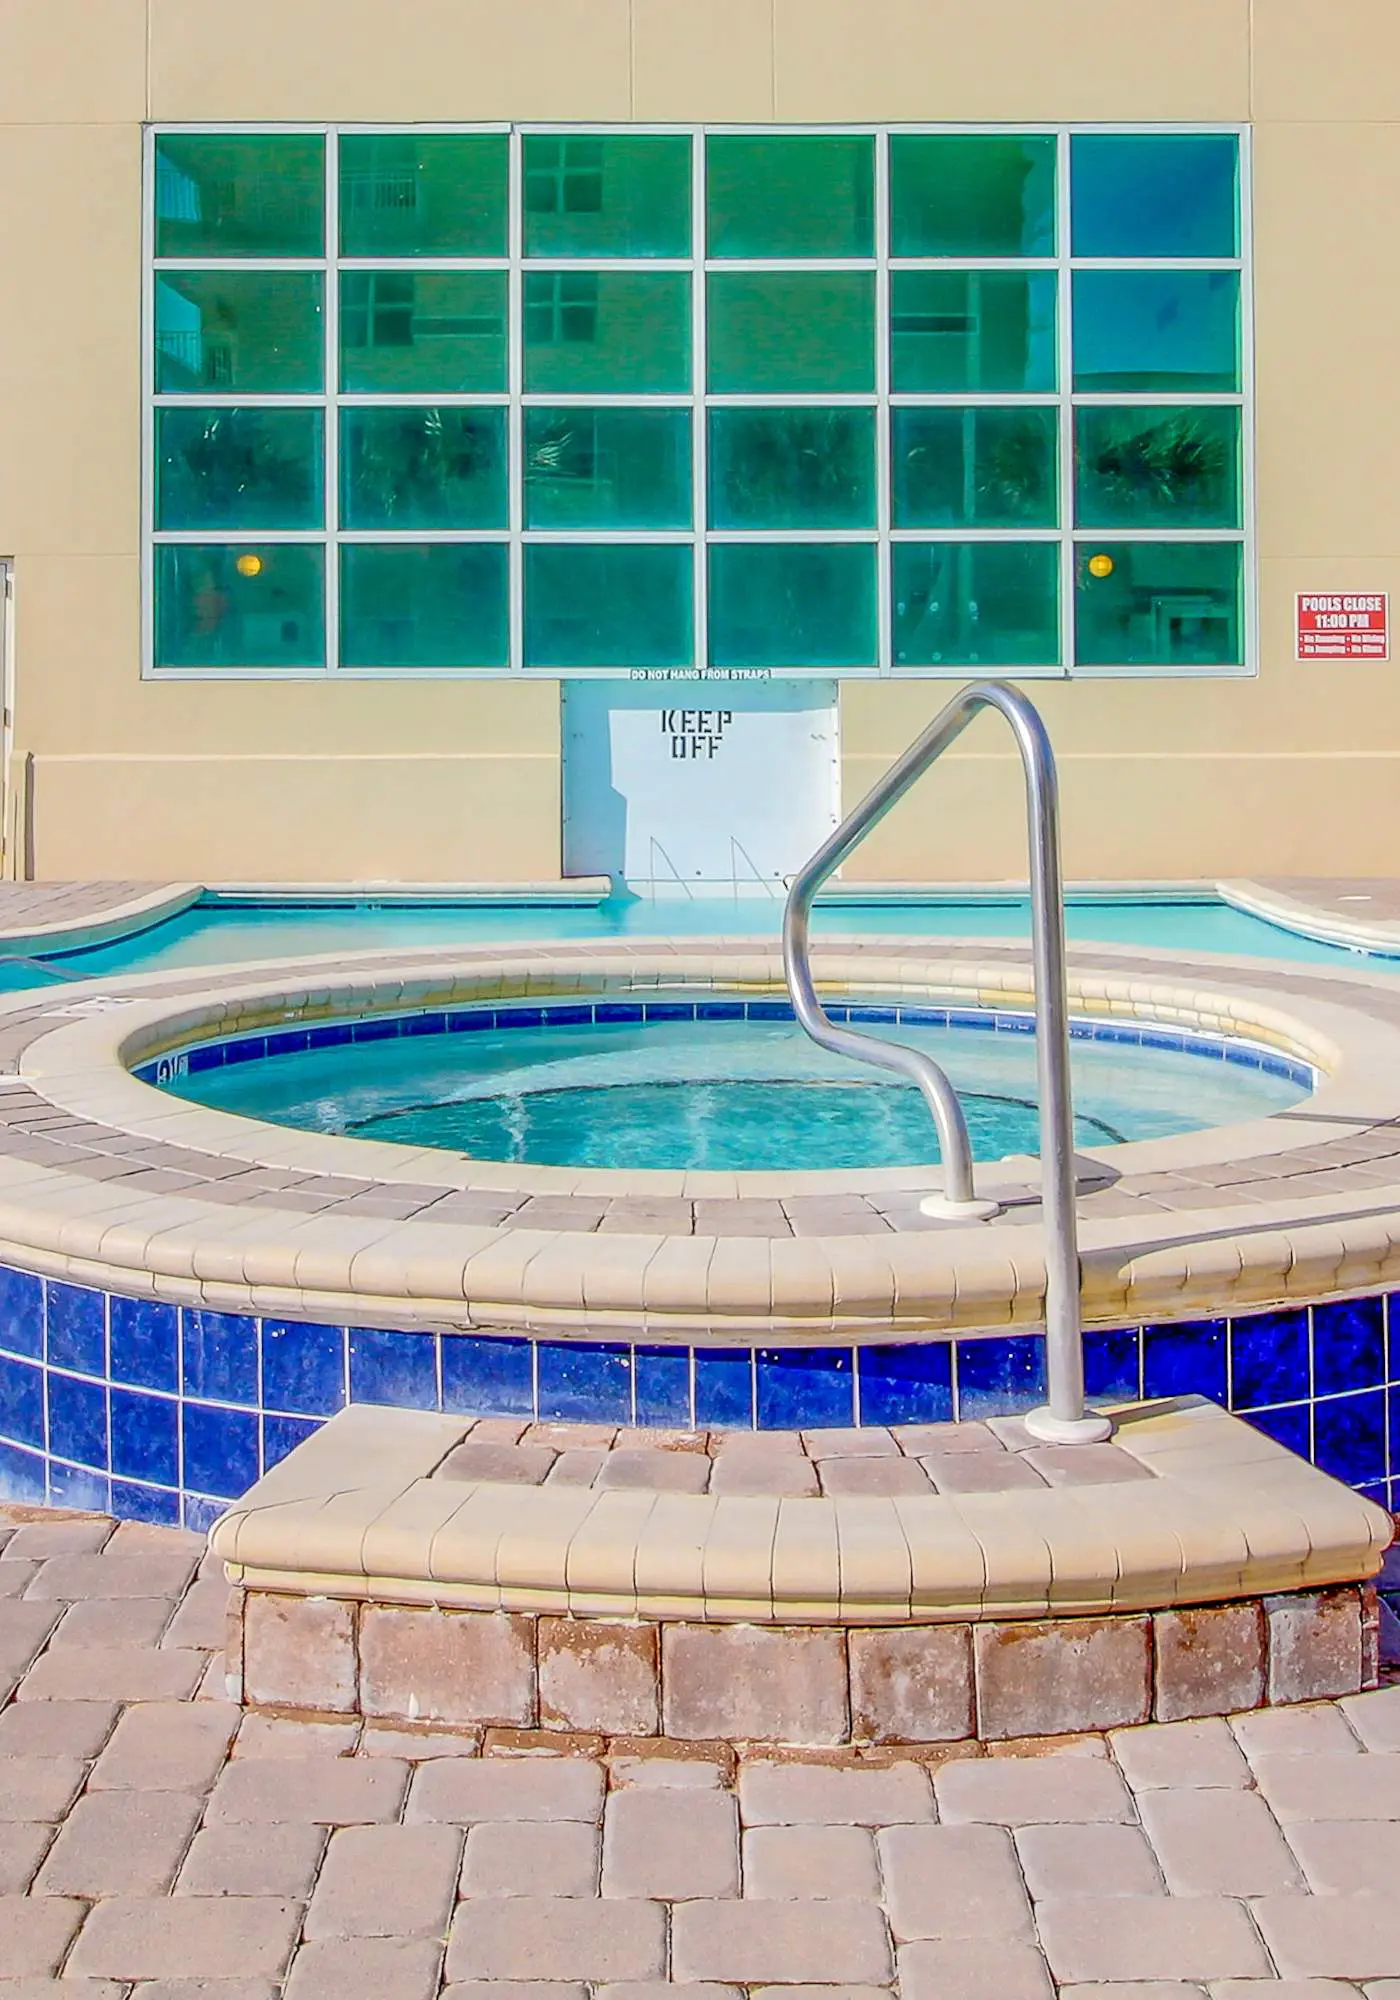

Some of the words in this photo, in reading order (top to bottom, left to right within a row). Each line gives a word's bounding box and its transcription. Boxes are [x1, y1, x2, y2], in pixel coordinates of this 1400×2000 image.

[1302, 597, 1342, 611] POOLS
[1343, 597, 1382, 611] CLOSE
[1315, 614, 1348, 628] 11:00
[1349, 614, 1370, 628] PM
[631, 669, 647, 680] DO
[647, 669, 669, 680] NOT
[670, 669, 701, 680] HANG
[703, 669, 729, 680] FROM
[730, 669, 770, 680] STRAPS
[662, 710, 732, 733] KEEP
[672, 736, 723, 759] OFF
